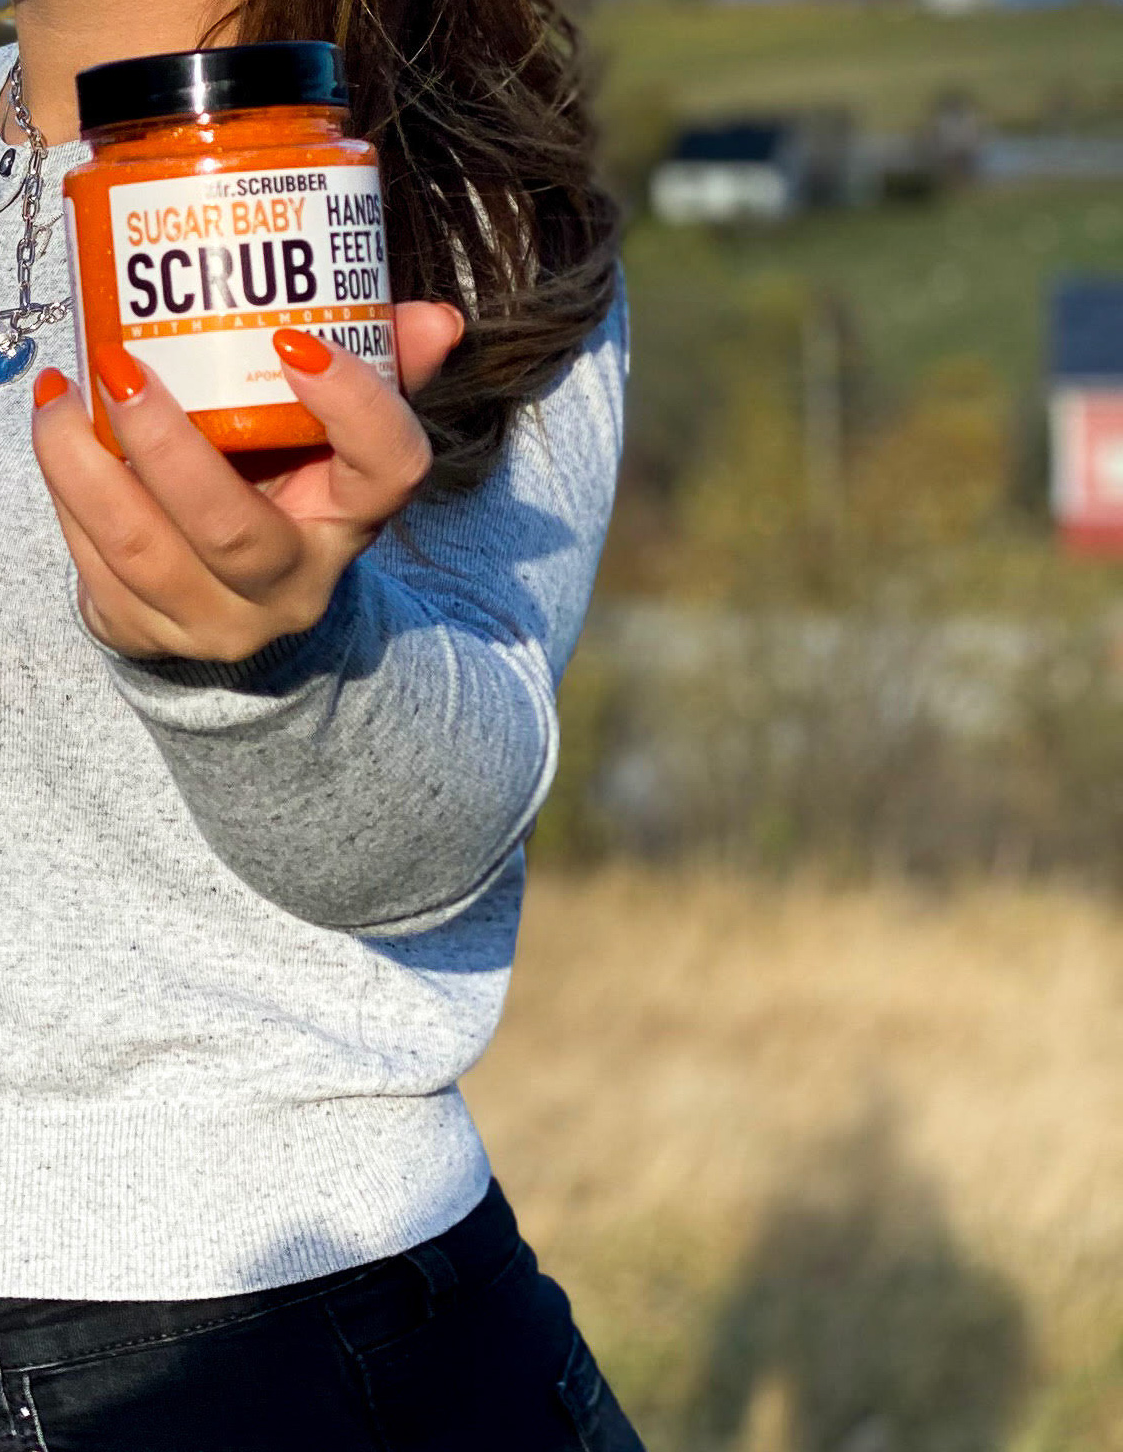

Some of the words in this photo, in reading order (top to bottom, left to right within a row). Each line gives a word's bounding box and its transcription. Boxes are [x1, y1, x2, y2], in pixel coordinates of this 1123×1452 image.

[127, 204, 224, 246] SUGAR
[231, 197, 306, 236] BABY
[326, 193, 382, 227] HANDS
[329, 231, 372, 264] FEET
[376, 231, 385, 262] &
[127, 238, 317, 317] SCRUB
[333, 268, 380, 301] BODY
[131, 319, 203, 338] WITH
[234, 307, 351, 327] ALMOND
